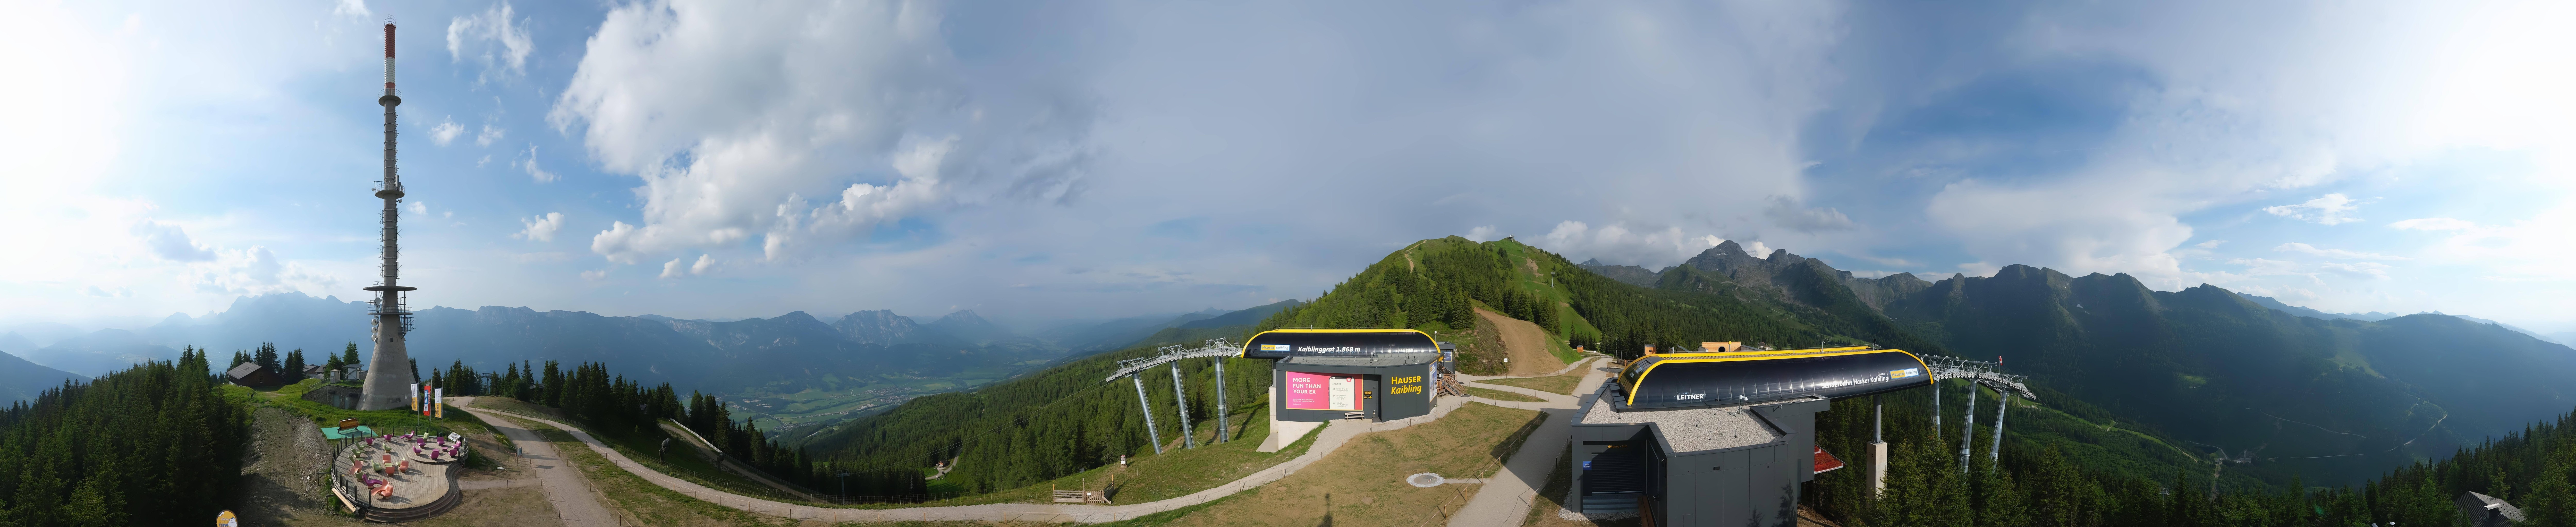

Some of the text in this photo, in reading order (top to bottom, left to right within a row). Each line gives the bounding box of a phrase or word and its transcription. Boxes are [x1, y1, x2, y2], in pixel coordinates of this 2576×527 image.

[1392, 376, 1421, 384] HAUSER
[1822, 380, 1852, 388] Senderbahn
[1391, 385, 1421, 395] Kaibling
